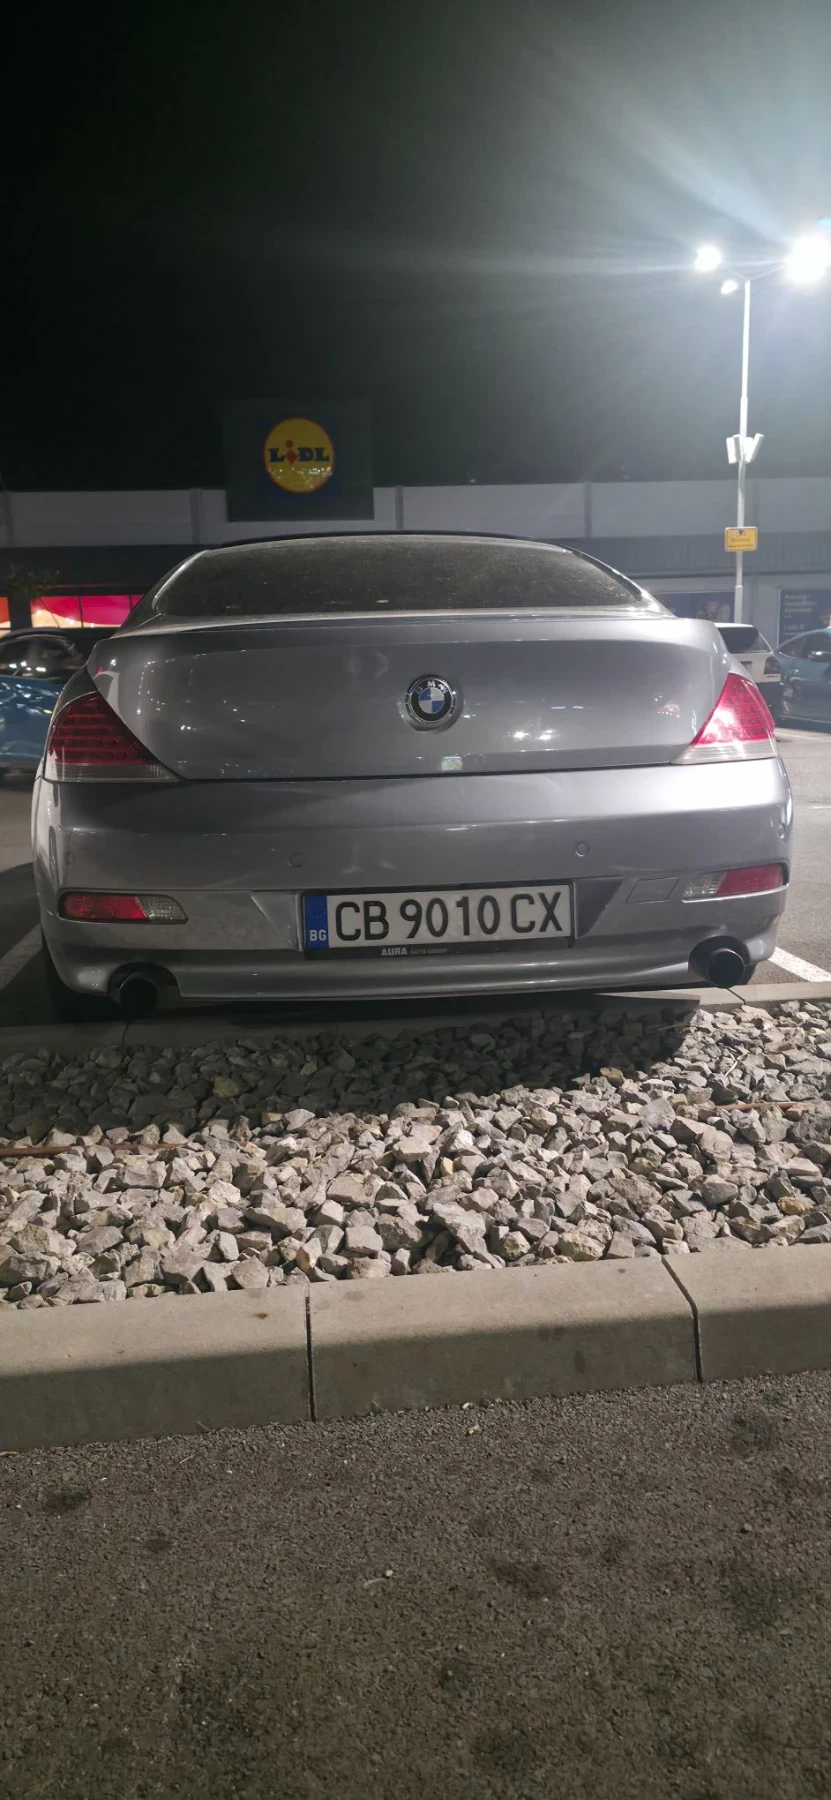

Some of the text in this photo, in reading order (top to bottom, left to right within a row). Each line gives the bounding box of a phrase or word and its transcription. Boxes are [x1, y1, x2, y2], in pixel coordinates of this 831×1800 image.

[335, 891, 563, 942] CB 9010 CX
[309, 929, 327, 942] BG
[381, 947, 408, 957] AURA
